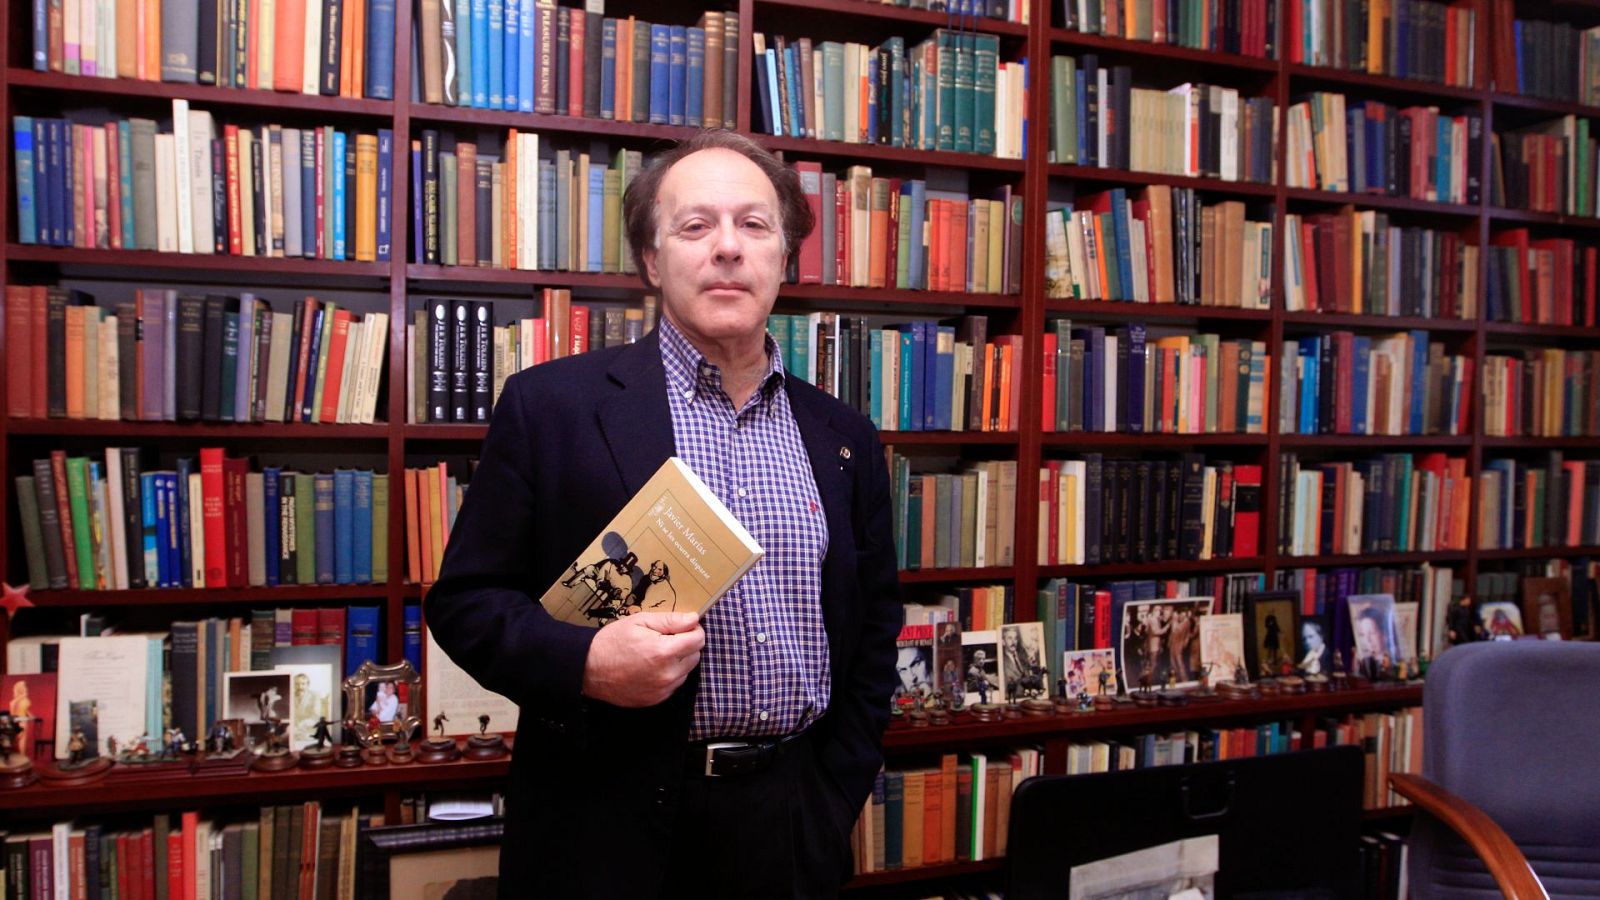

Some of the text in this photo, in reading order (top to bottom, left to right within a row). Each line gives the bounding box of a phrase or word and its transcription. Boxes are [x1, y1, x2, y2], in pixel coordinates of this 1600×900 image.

[541, 10, 551, 94] PLEASURE OF RUINS
[656, 517, 665, 528] Ni
[664, 506, 707, 555] Javier Marías
